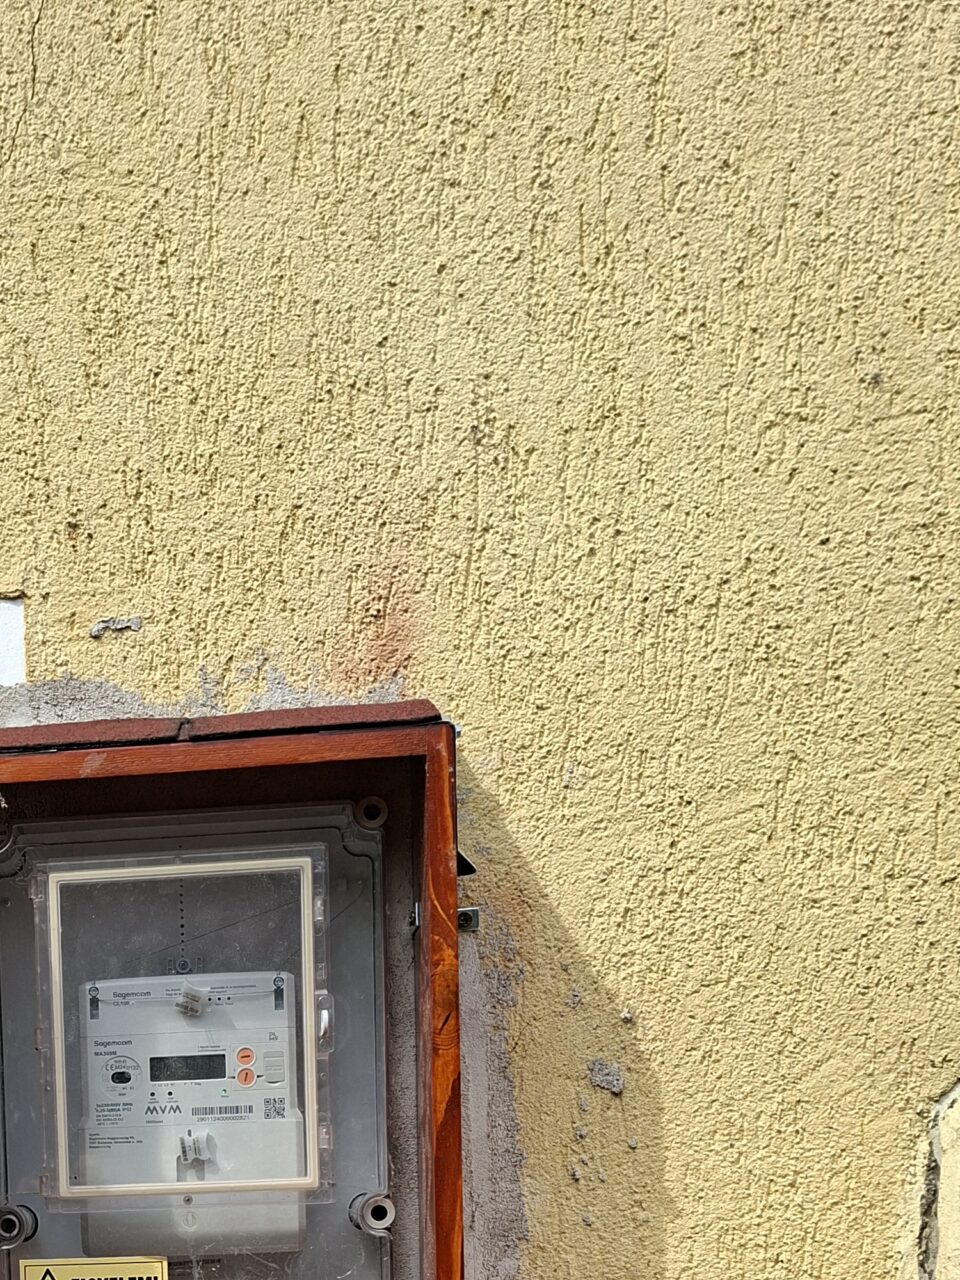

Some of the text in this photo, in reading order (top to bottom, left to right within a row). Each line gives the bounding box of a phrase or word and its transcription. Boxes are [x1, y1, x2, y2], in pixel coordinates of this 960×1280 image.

[112, 991, 151, 999] Sagemcom
[93, 1040, 132, 1048] Sagemcom
[145, 1104, 182, 1115] MVM
